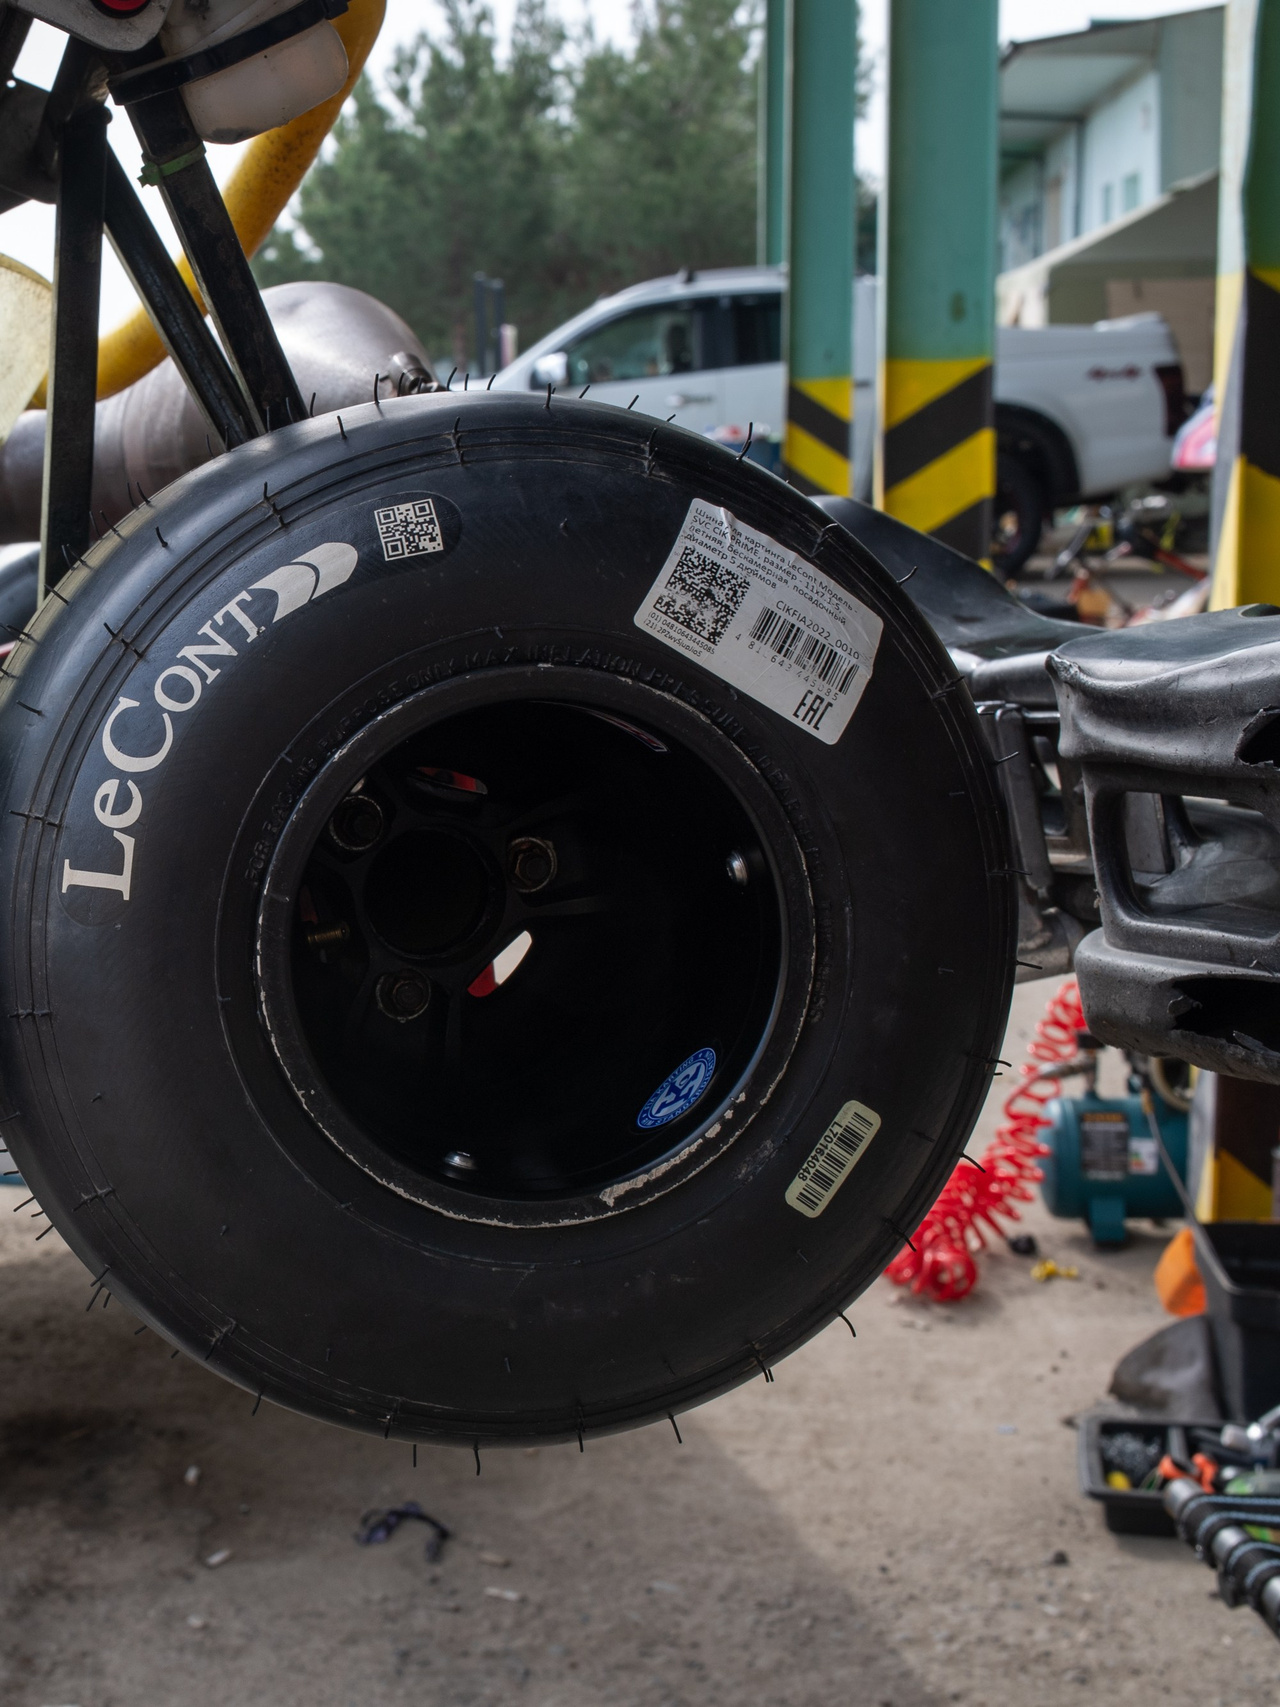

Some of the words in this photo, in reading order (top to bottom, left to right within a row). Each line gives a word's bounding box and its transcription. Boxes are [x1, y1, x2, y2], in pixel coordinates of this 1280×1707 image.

[683, 530, 729, 562] диаметр
[728, 555, 738, 565] 5
[736, 560, 779, 590] дюймов
[691, 514, 712, 530] SVC
[711, 524, 729, 540] CIK
[762, 555, 798, 582] размер
[694, 506, 724, 528] Шина
[743, 534, 787, 564] картинга
[785, 560, 818, 585] LeCont
[817, 580, 854, 611] Модель
[774, 598, 862, 661] CIKFIA2022_0010
[791, 584, 848, 626] посадочный
[791, 687, 834, 731] EAC
[796, 1120, 843, 1183] L70164048
